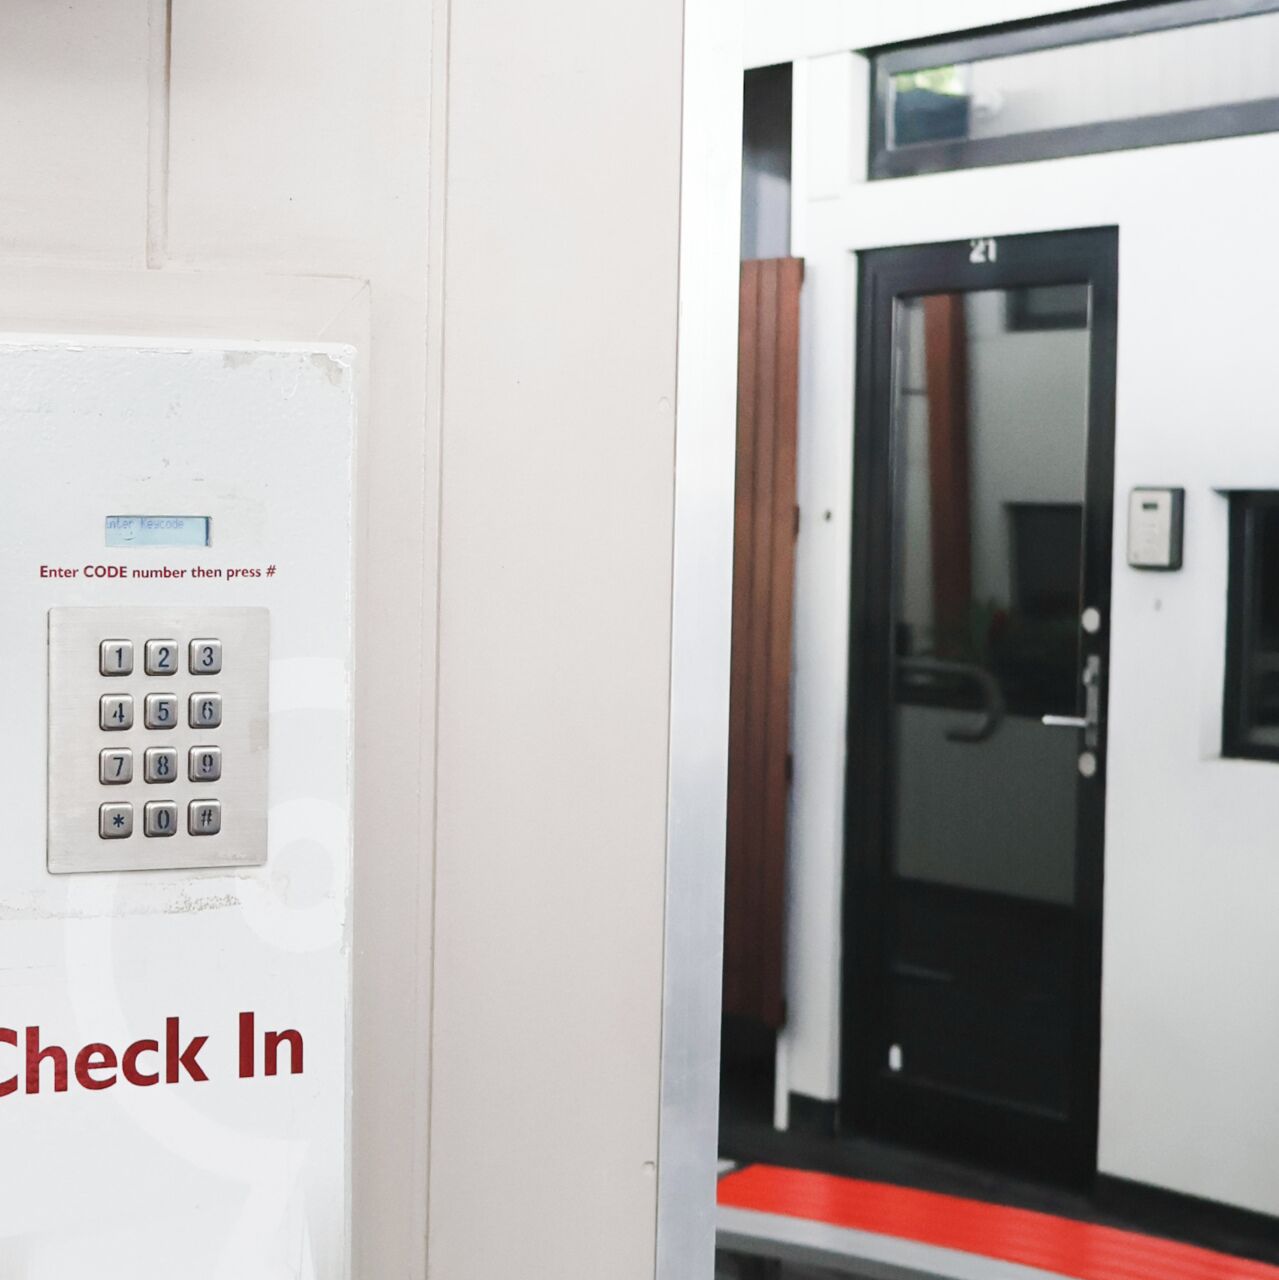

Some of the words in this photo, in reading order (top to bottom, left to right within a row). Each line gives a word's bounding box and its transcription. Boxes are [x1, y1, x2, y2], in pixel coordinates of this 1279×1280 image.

[969, 238, 997, 263] 21
[39, 564, 80, 579] Enter
[83, 564, 128, 579] CODE
[132, 565, 187, 579] number
[190, 565, 223, 579] then
[226, 568, 262, 582] press
[265, 564, 277, 578] #
[113, 646, 124, 668] 1
[157, 646, 170, 669] 2
[202, 645, 214, 667] 3
[112, 702, 125, 723] 4
[157, 701, 170, 722] 5
[201, 700, 213, 721] 6
[113, 756, 124, 778] 7
[157, 754, 169, 776] 8
[201, 753, 213, 774] 9
[238, 1011, 304, 1079] In
